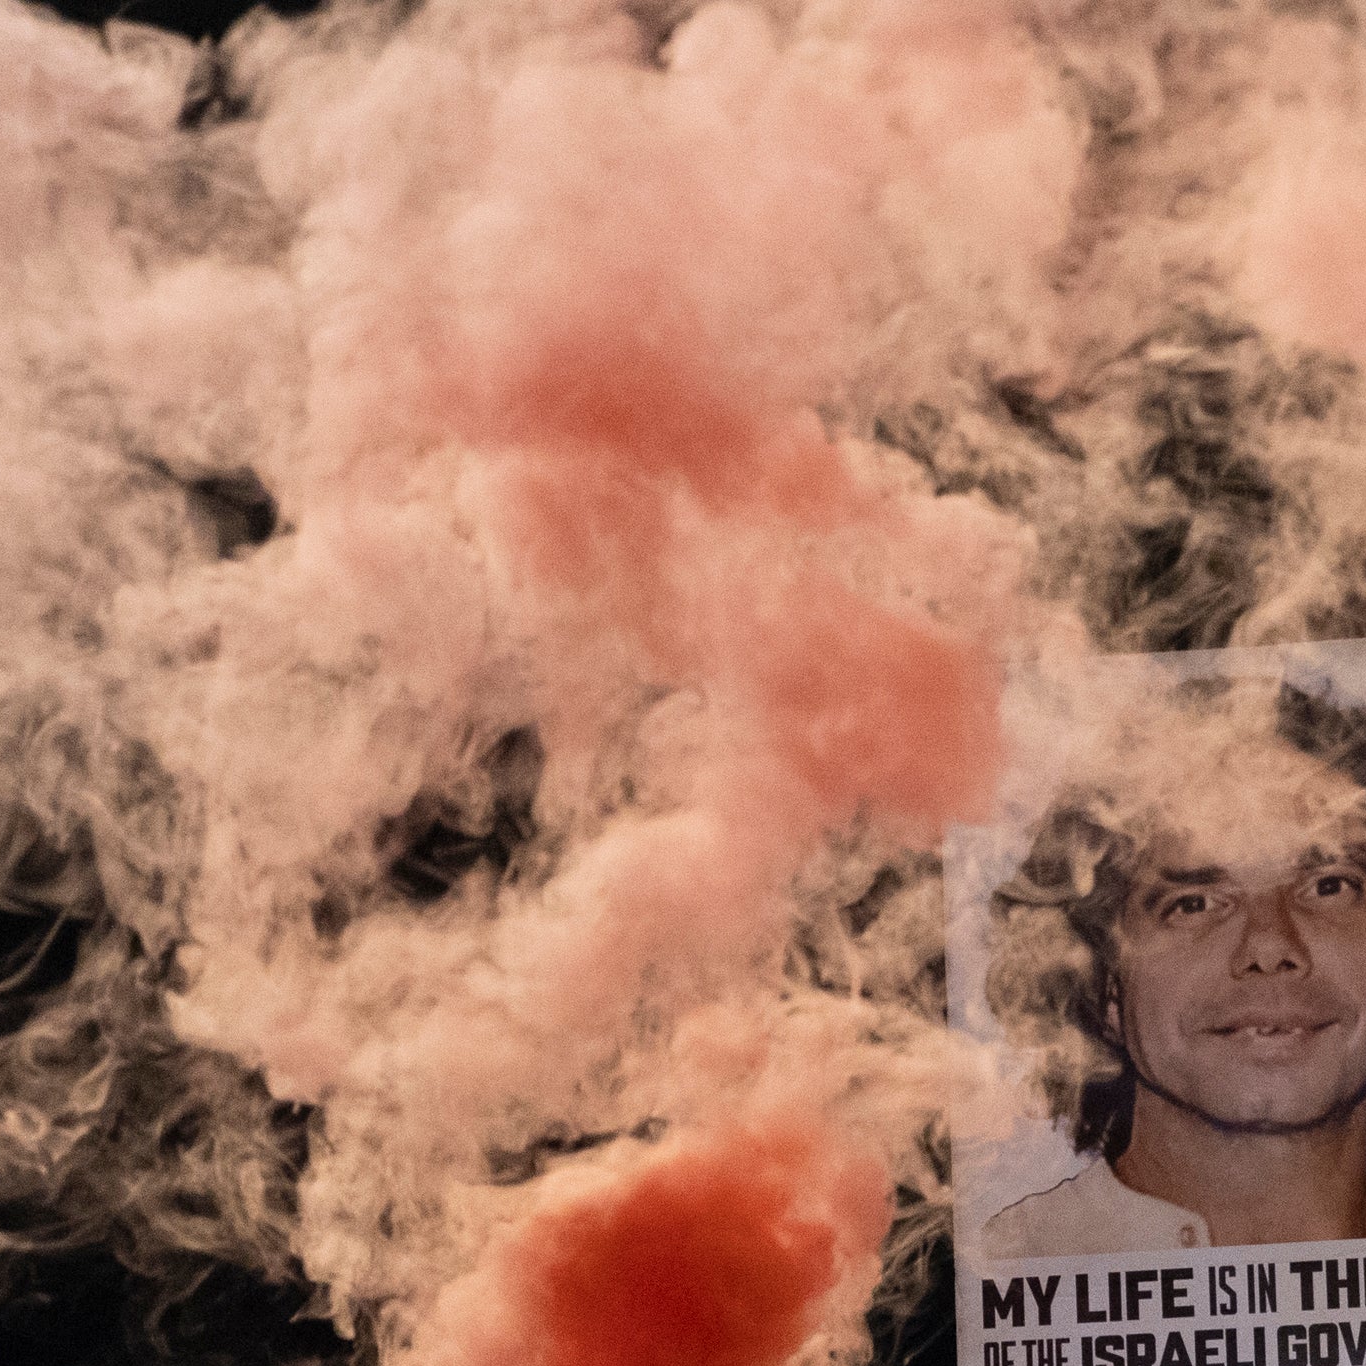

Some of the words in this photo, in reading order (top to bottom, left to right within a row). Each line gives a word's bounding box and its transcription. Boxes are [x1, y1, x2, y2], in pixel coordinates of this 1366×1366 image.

[982, 1275, 1061, 1329] MY
[1075, 1267, 1195, 1323] LIFE
[1208, 1265, 1237, 1316] IS
[1247, 1262, 1277, 1314] IN
